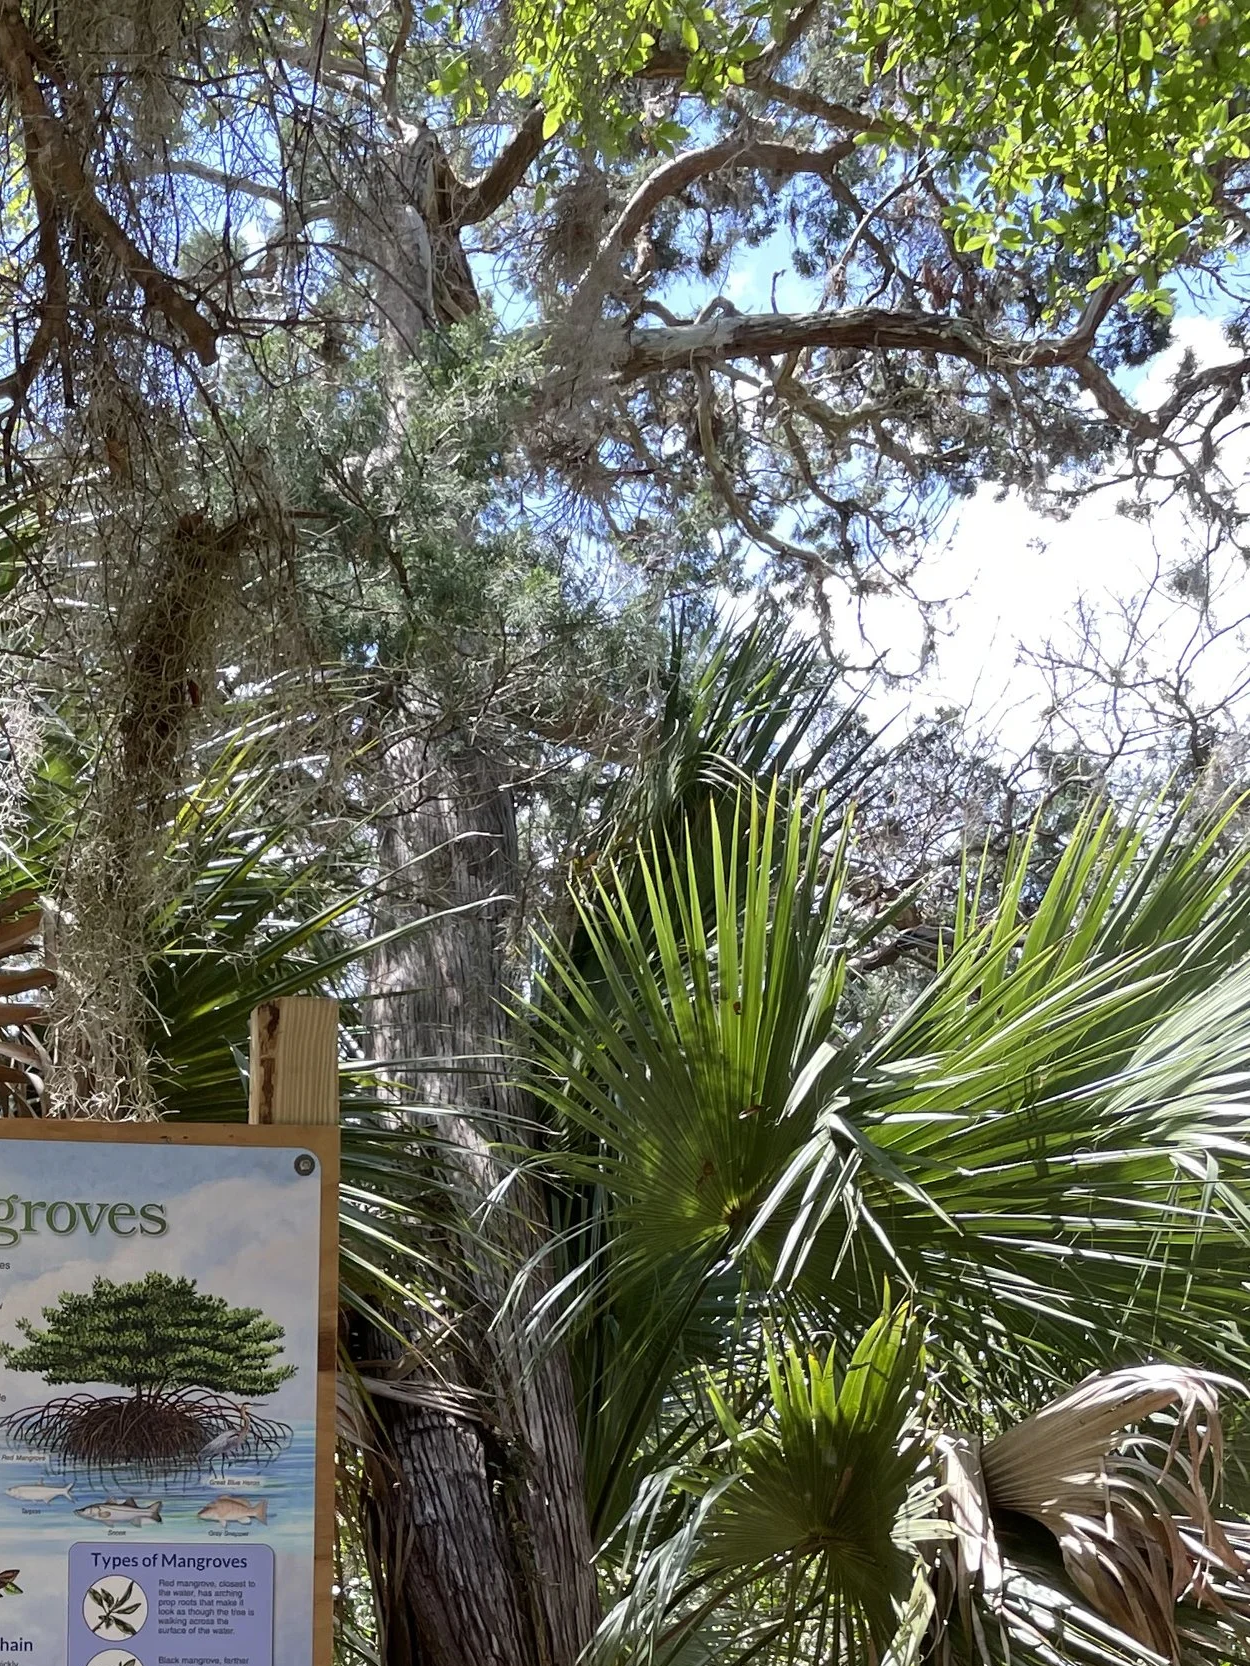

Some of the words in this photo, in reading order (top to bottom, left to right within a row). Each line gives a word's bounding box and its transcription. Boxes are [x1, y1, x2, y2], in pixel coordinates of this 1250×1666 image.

[91, 1553, 138, 1570] Types
[142, 1554, 158, 1567] of
[162, 1554, 247, 1570] Mangroves
